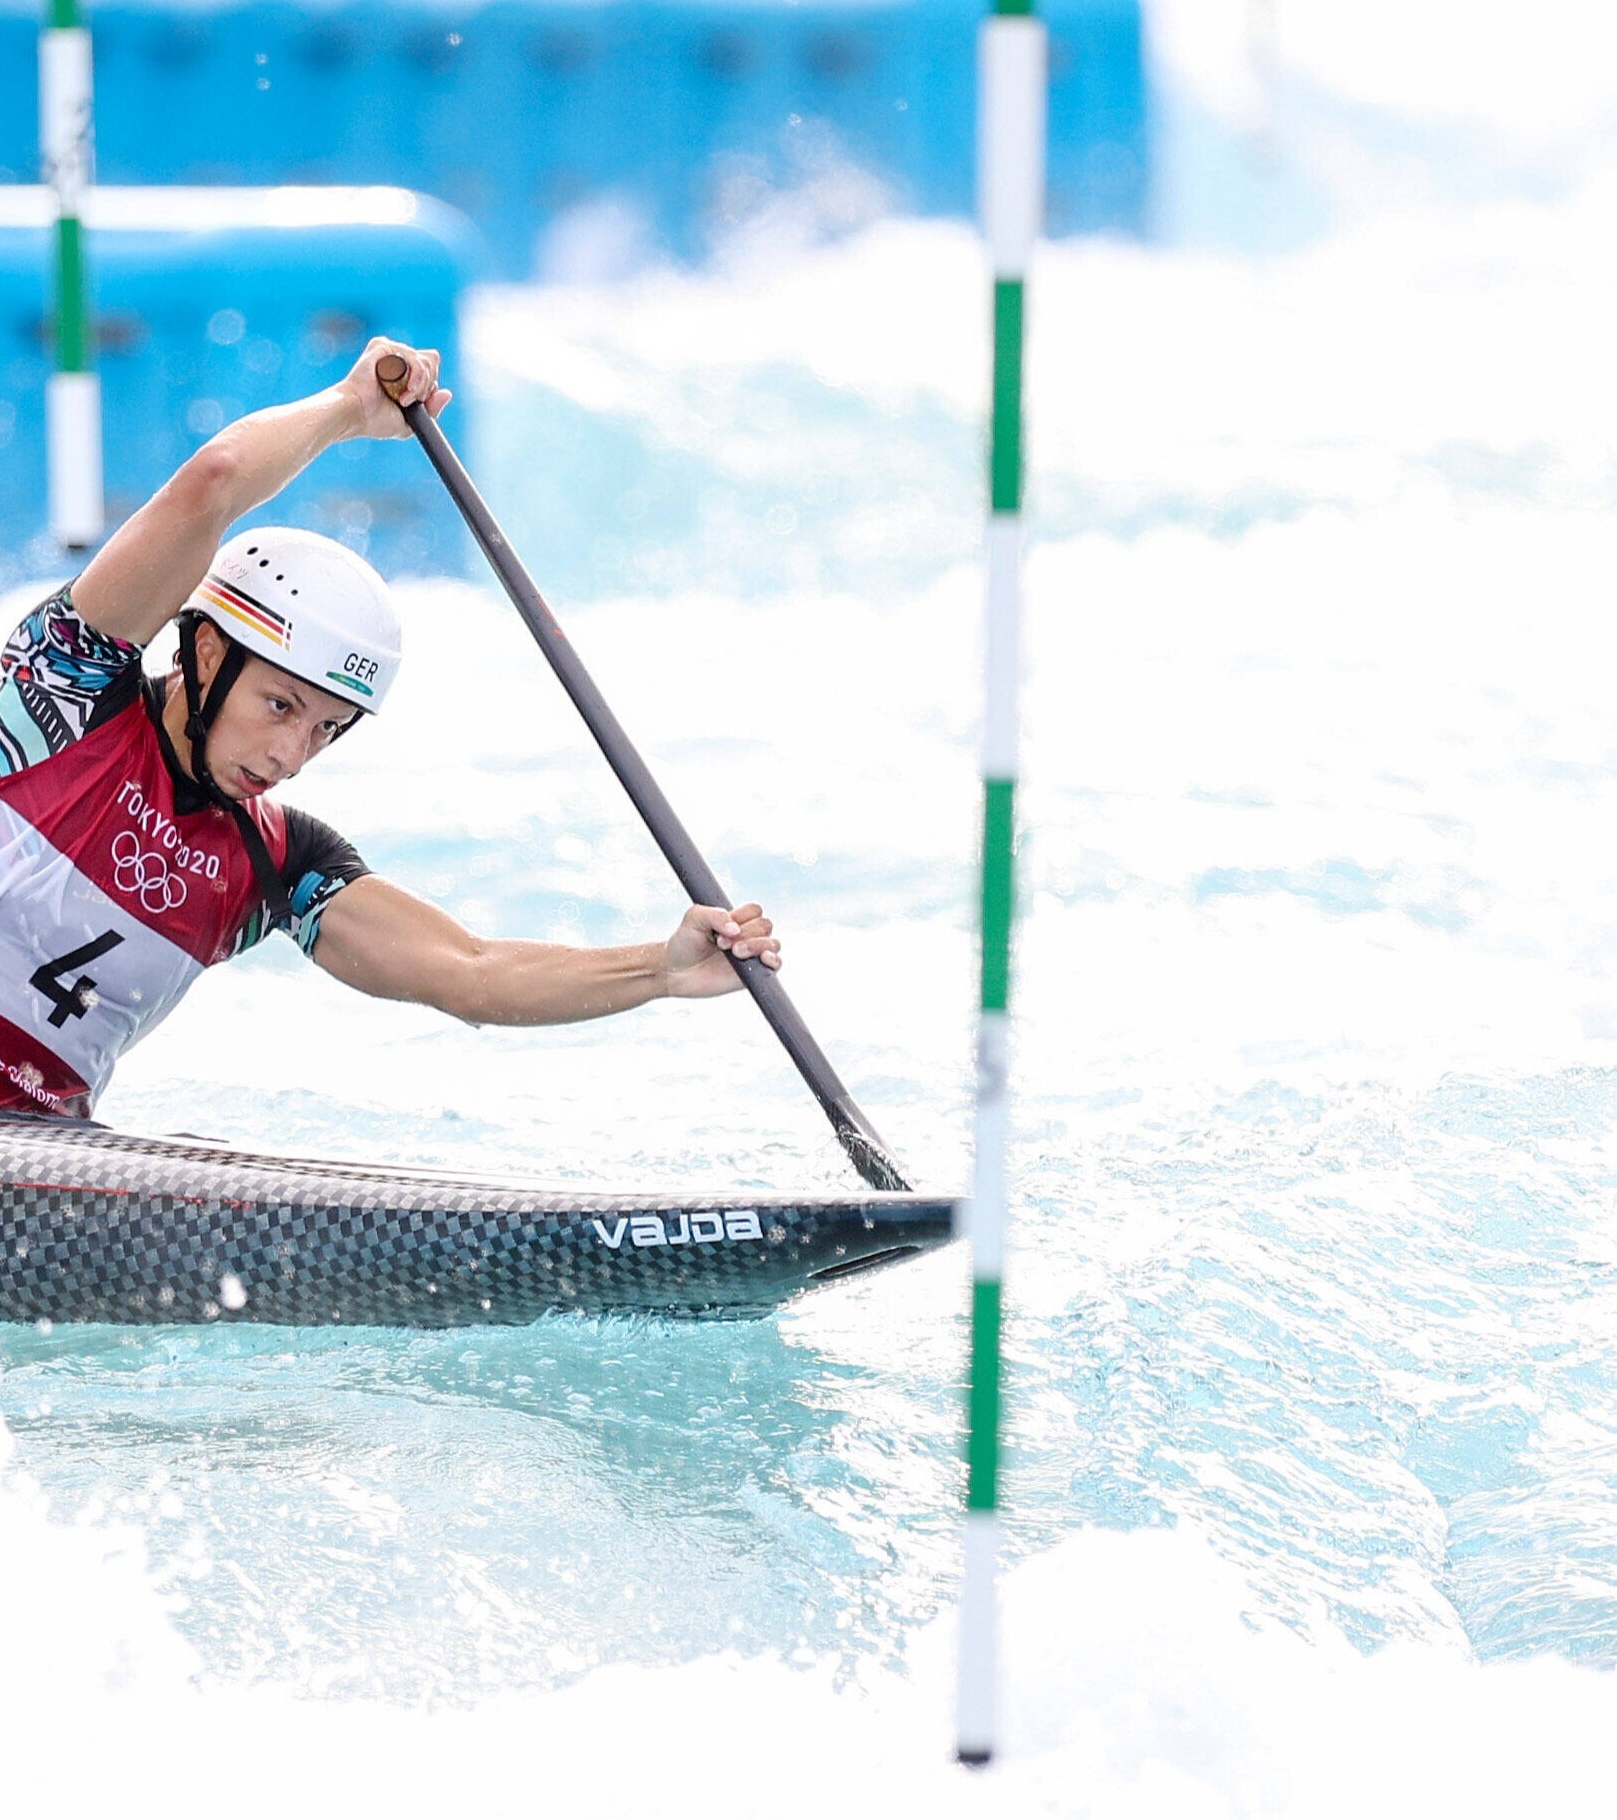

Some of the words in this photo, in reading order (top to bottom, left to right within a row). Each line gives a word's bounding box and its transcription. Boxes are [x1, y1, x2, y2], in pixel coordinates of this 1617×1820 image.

[343, 653, 379, 682] GER
[117, 780, 178, 849] TOKYO
[28, 928, 126, 1029] 4
